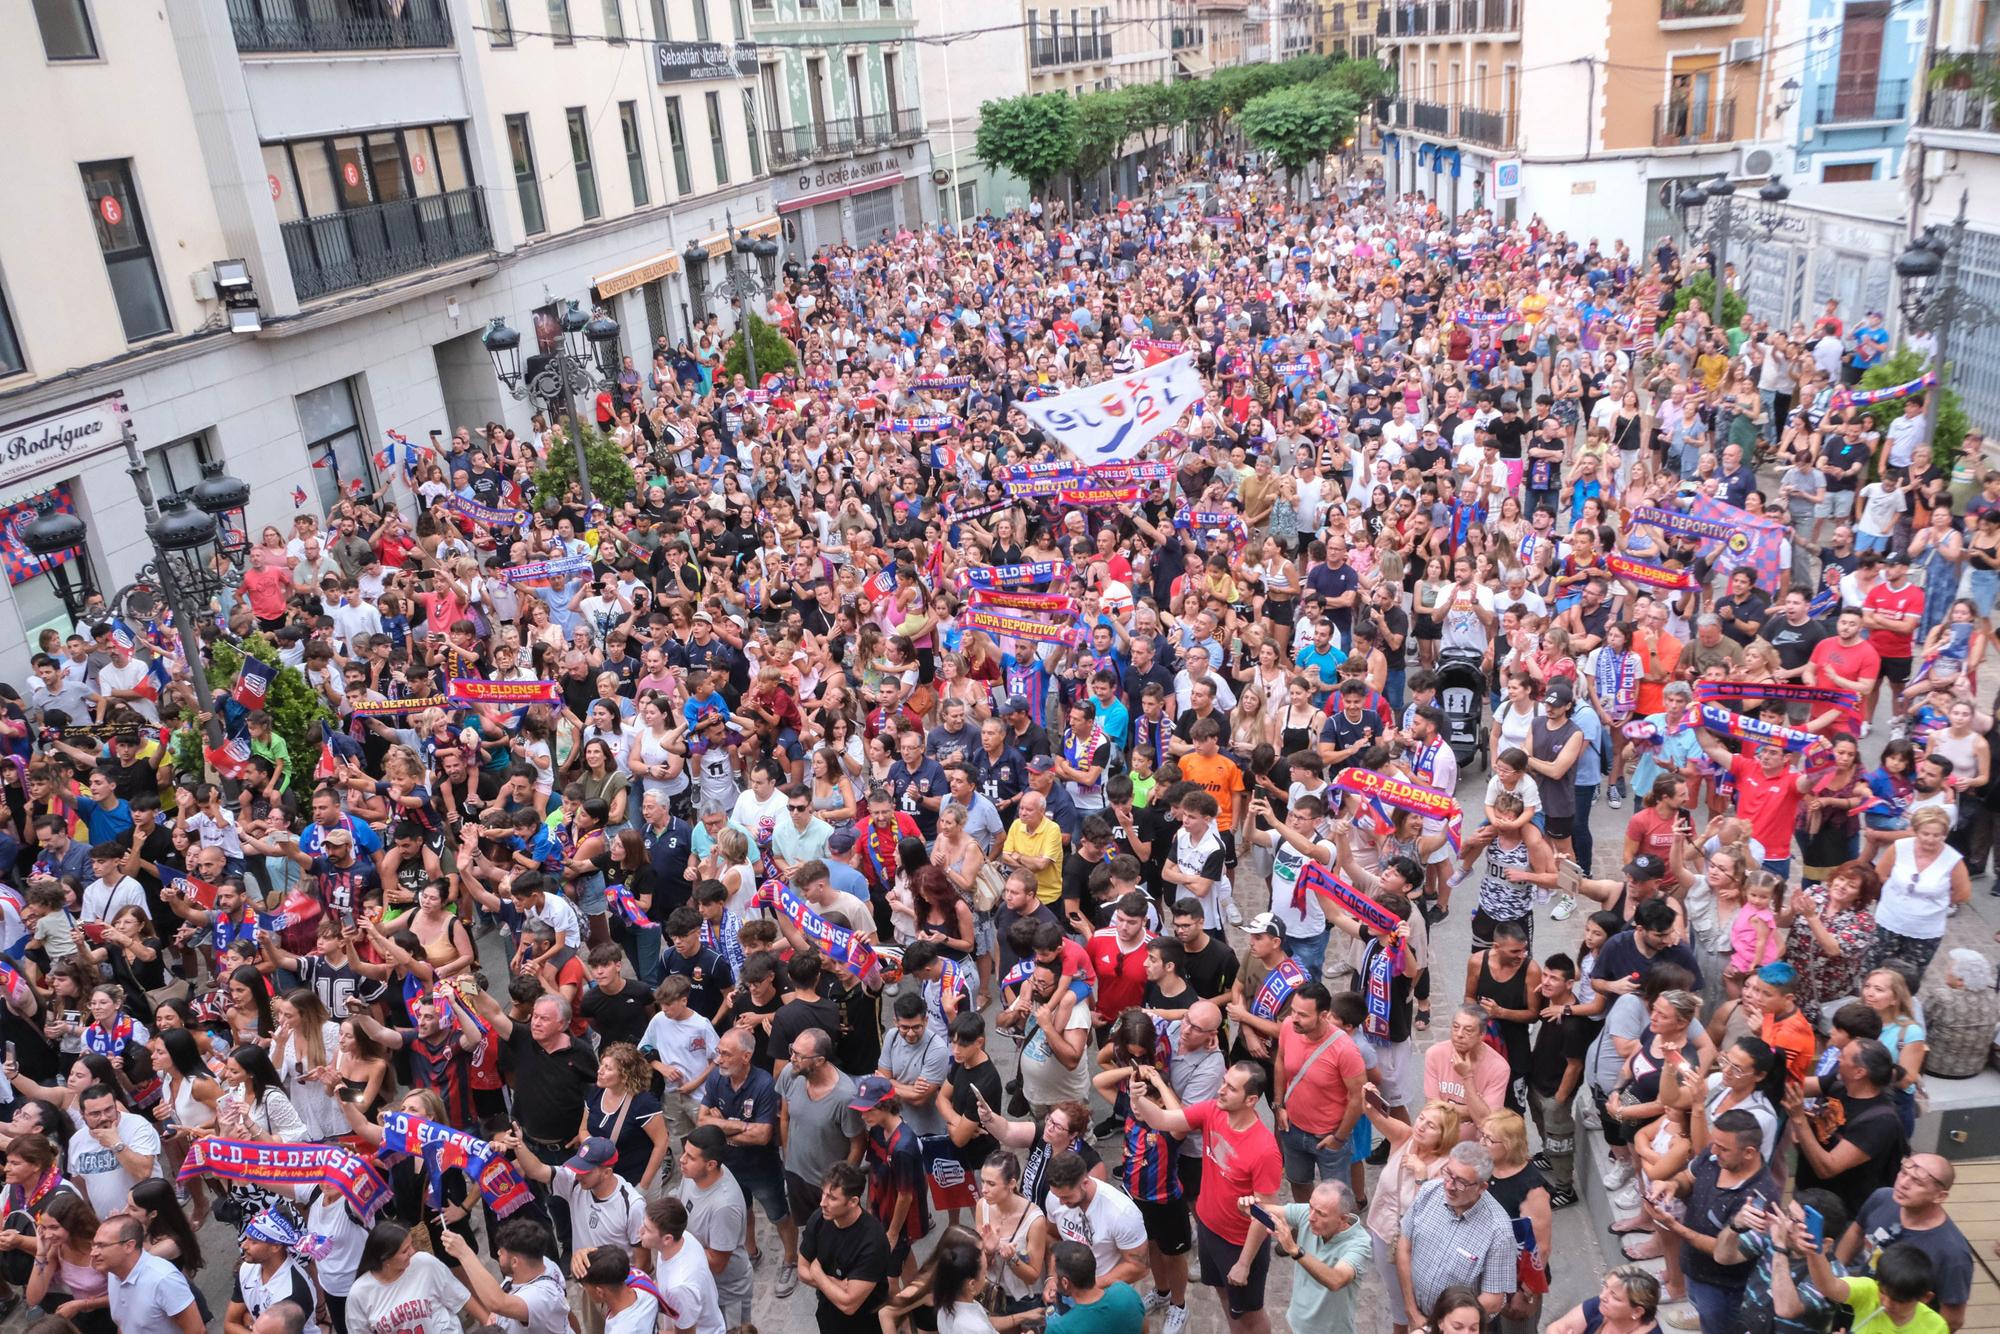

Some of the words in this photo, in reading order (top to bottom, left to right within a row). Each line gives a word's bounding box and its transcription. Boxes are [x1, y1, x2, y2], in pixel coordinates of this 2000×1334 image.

[660, 47, 700, 67] Sebastián
[860, 162, 884, 177] SANTA
[885, 158, 900, 170] ANA
[913, 416, 953, 427] ELDENSE
[7, 420, 104, 461] Rodríguez
[1010, 465, 1029, 474] C.D.
[1031, 461, 1072, 473] ELDENSE
[1009, 478, 1079, 495] DEPORTIVO
[1638, 508, 1668, 525] AUPA
[1670, 516, 1736, 538] DEPORTIVO
[969, 571, 994, 580] C.D.
[995, 563, 1052, 578] ELDENSE
[1612, 559, 1633, 572] C.D.
[1633, 565, 1680, 583] ELDENSE
[974, 613, 1000, 627] AUPA
[1001, 617, 1058, 636] DEPORTIVO
[466, 683, 489, 695] C.D.
[490, 684, 542, 695] ELDENSE
[355, 700, 380, 711] UPA
[1703, 704, 1735, 725] C.D.
[1737, 714, 1820, 744] ELDENSE
[1352, 769, 1380, 790] C.D.
[1381, 779, 1452, 810] ELDENSE
[669, 837, 677, 849] 3
[780, 892, 800, 921] C.D.
[800, 908, 850, 948] ELDENSE
[317, 977, 354, 1018] 16
[383, 1111, 413, 1137] C.D.
[209, 1142, 249, 1166] C.D.
[258, 1148, 362, 1179] ELDENSE
[251, 1227, 268, 1243] ELDA
[270, 1211, 297, 1241] ASCENSO
[1062, 1217, 1096, 1239] TOMMY
